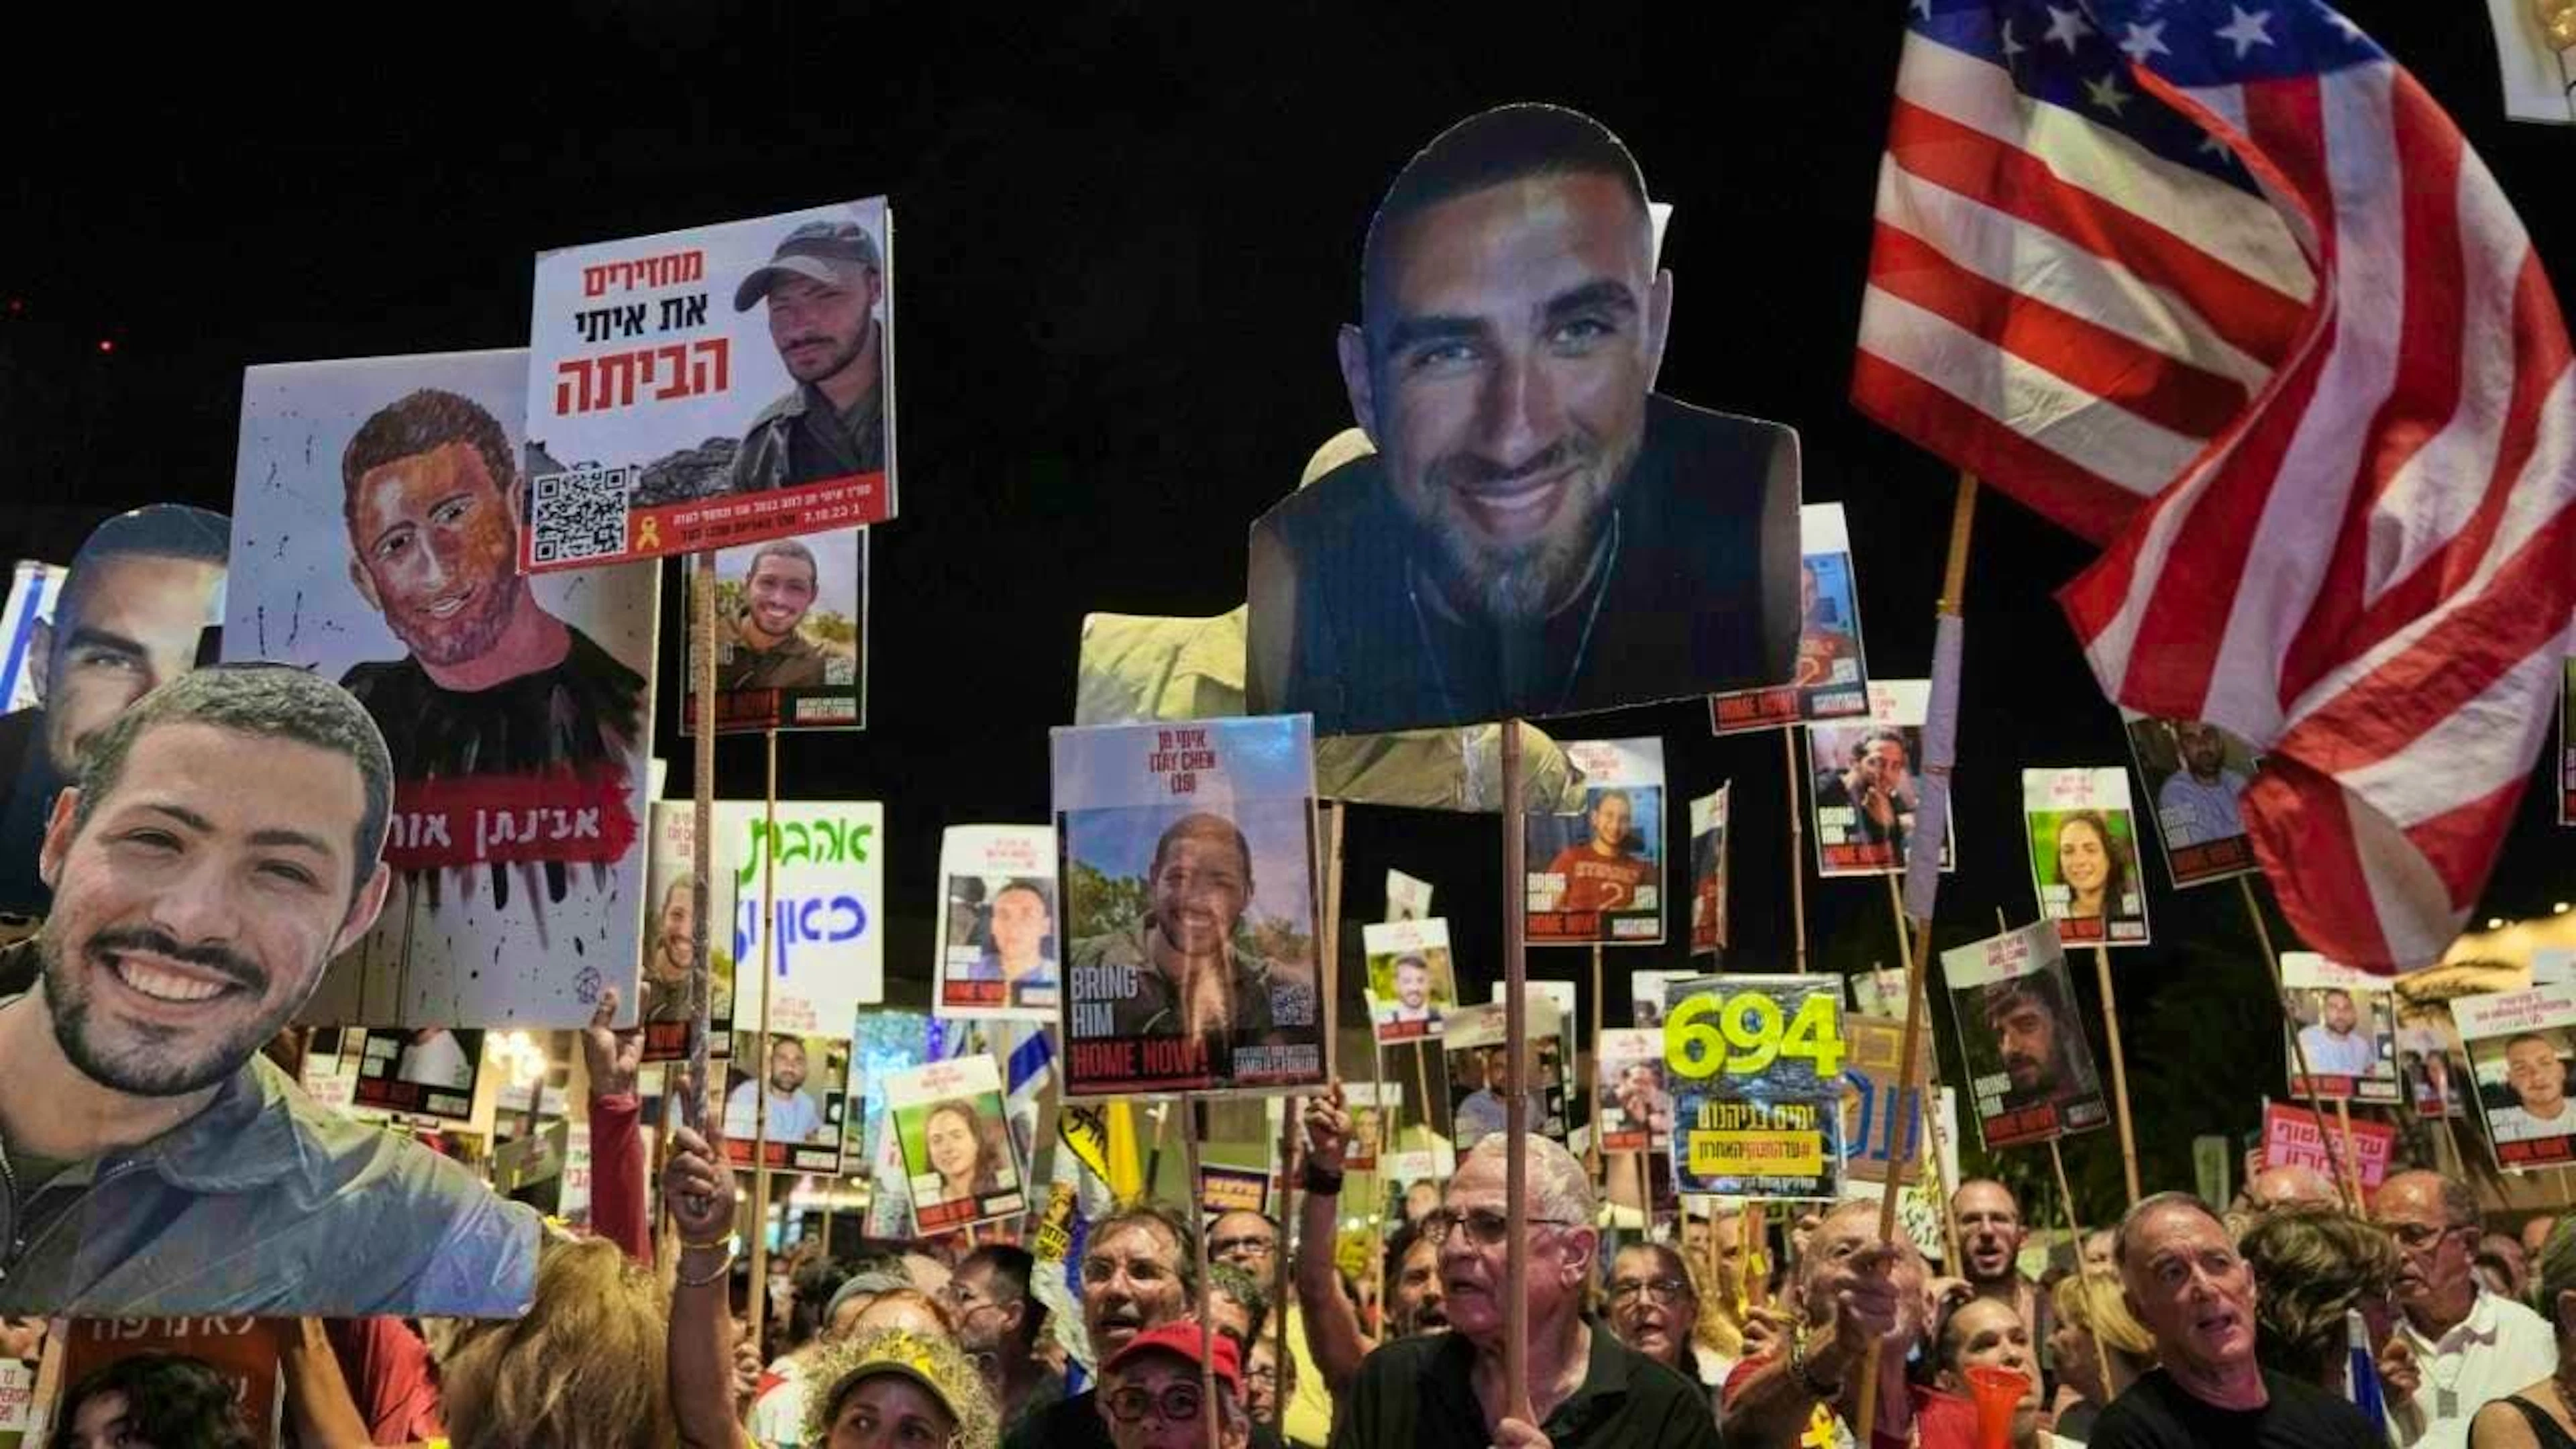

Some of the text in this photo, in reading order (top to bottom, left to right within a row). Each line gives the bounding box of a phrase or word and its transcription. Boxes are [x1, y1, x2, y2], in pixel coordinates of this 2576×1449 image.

[584, 250, 702, 296] מחזירים
[576, 294, 708, 342] את איתי
[556, 337, 728, 415] הביתה
[475, 807, 599, 858] אבינתן
[740, 818, 872, 885] אהבת
[1071, 966, 1138, 1000] BRING
[1072, 1002, 1114, 1038] HIM
[1664, 991, 1844, 1078] 694
[1073, 1038, 1208, 1075] HOME NOW!
